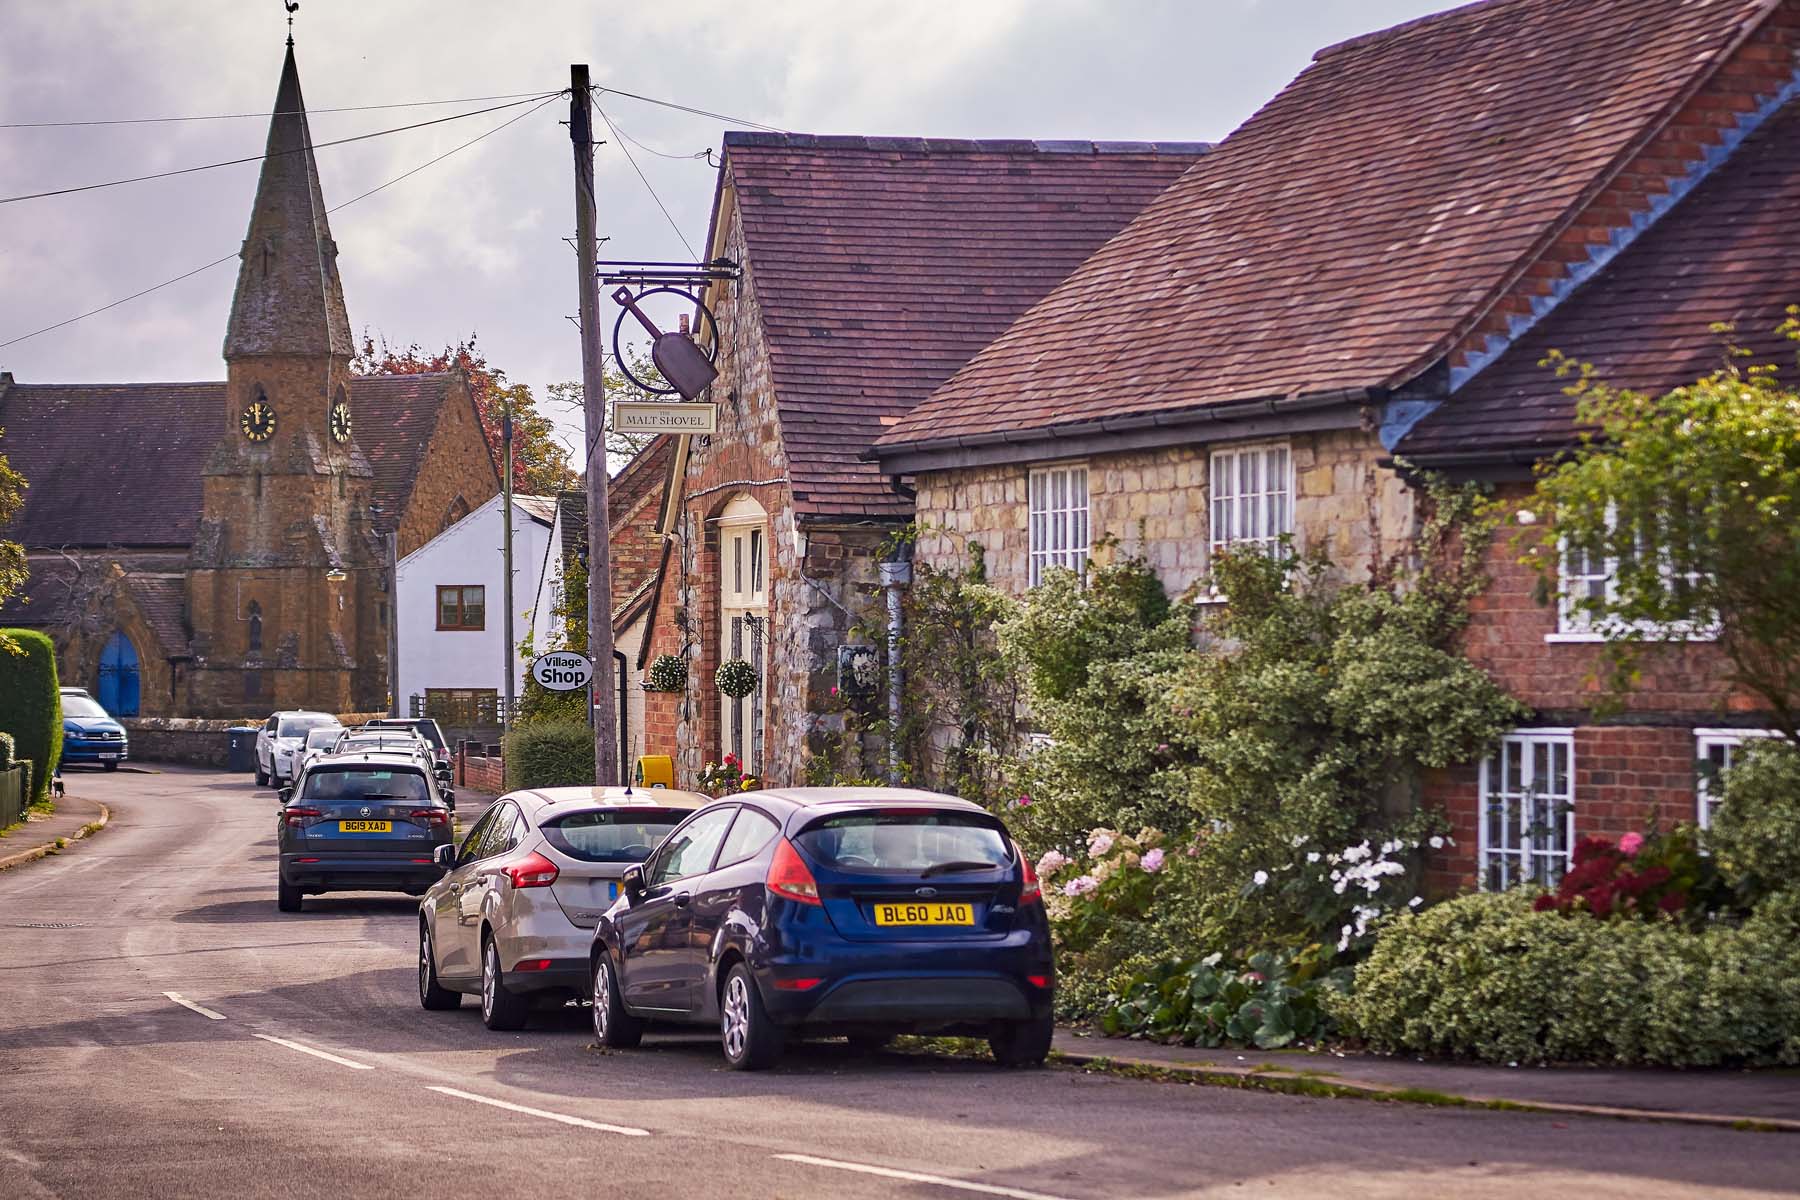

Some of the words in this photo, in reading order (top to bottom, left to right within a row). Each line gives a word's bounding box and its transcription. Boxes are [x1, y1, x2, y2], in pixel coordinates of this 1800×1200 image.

[626, 416, 658, 425] MALT
[659, 416, 705, 426] SHOVEL
[544, 657, 582, 669] Village
[541, 669, 585, 686] Shop
[345, 821, 366, 831] BG19
[367, 821, 386, 831] XAD
[883, 906, 929, 922] BL60
[934, 906, 966, 922] JAO
